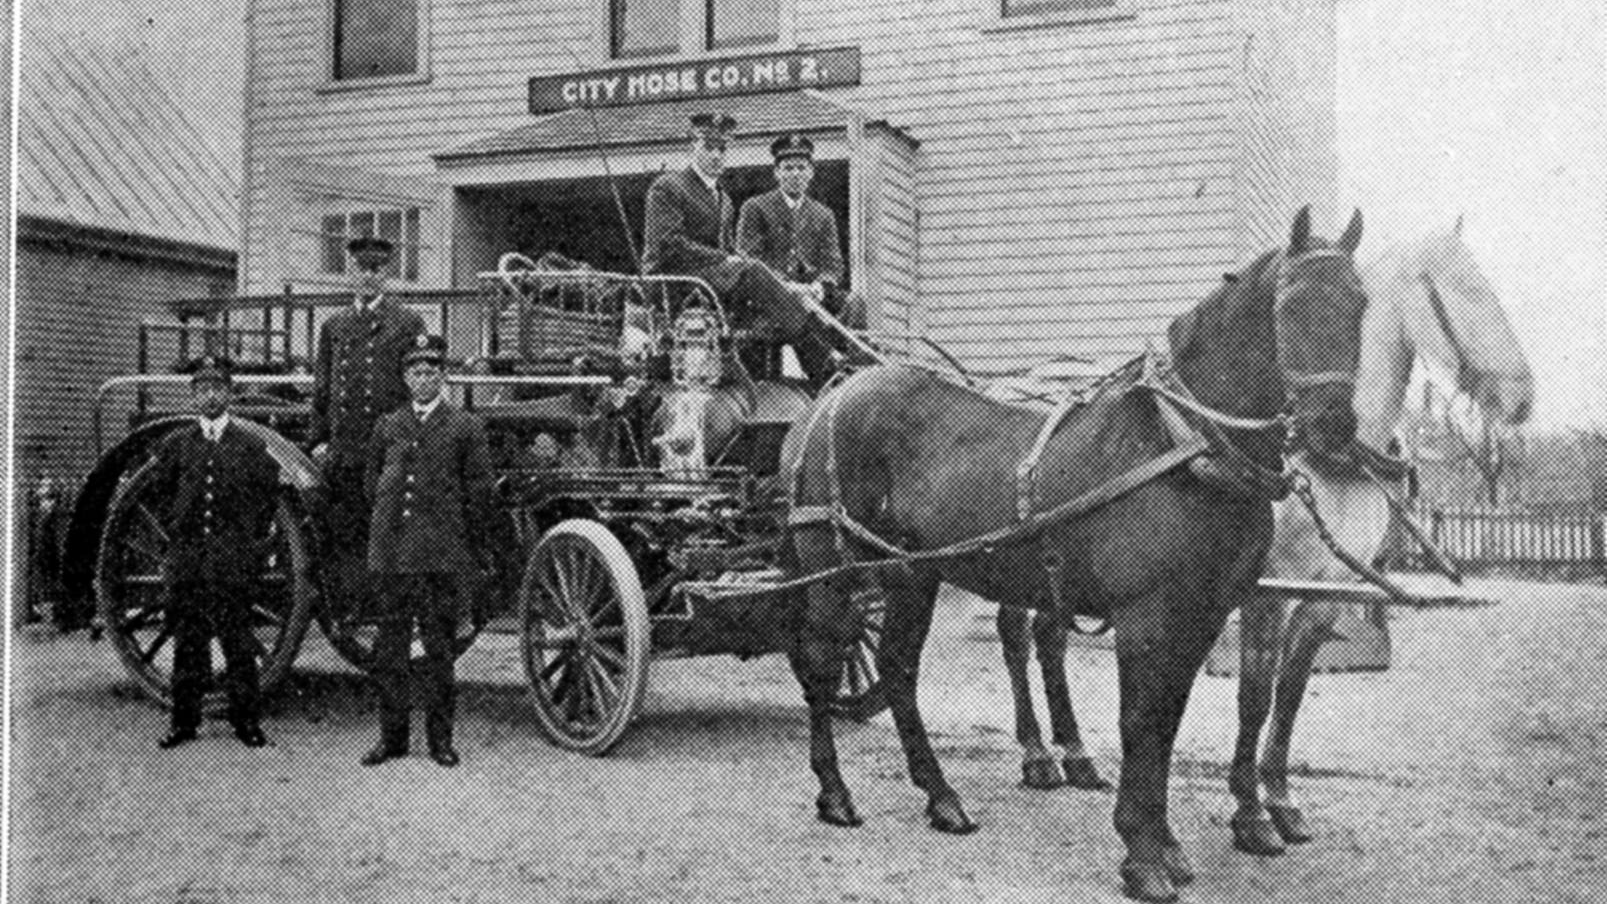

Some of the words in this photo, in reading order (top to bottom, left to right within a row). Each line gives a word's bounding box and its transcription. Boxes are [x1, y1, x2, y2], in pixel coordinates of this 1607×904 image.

[562, 77, 621, 102] CITY
[628, 69, 697, 97] HOSE
[704, 66, 749, 89] CO.
